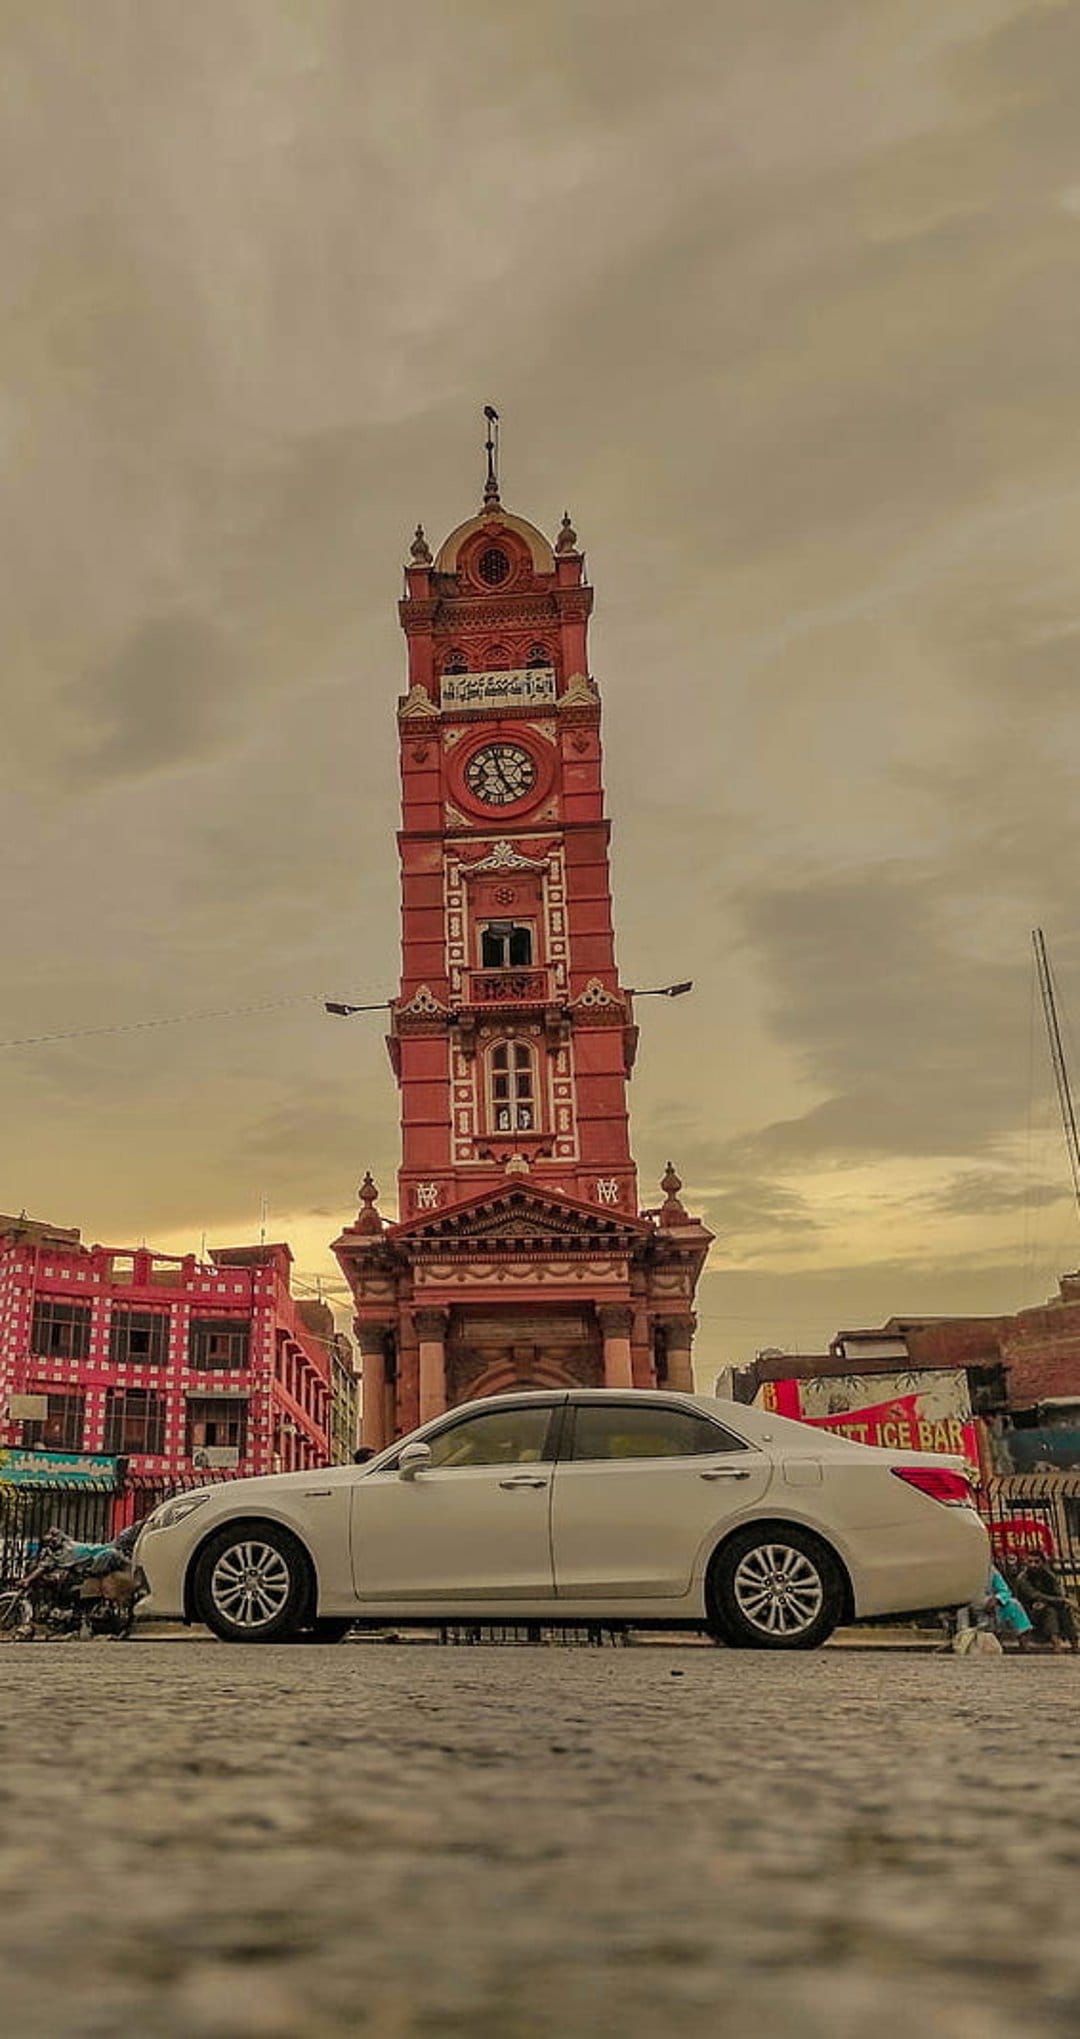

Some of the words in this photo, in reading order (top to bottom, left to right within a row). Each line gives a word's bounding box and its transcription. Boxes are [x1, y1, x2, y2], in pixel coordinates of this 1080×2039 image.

[825, 1424, 869, 1447] TT
[876, 1421, 912, 1449] ICE
[917, 1419, 965, 1454] BAR
